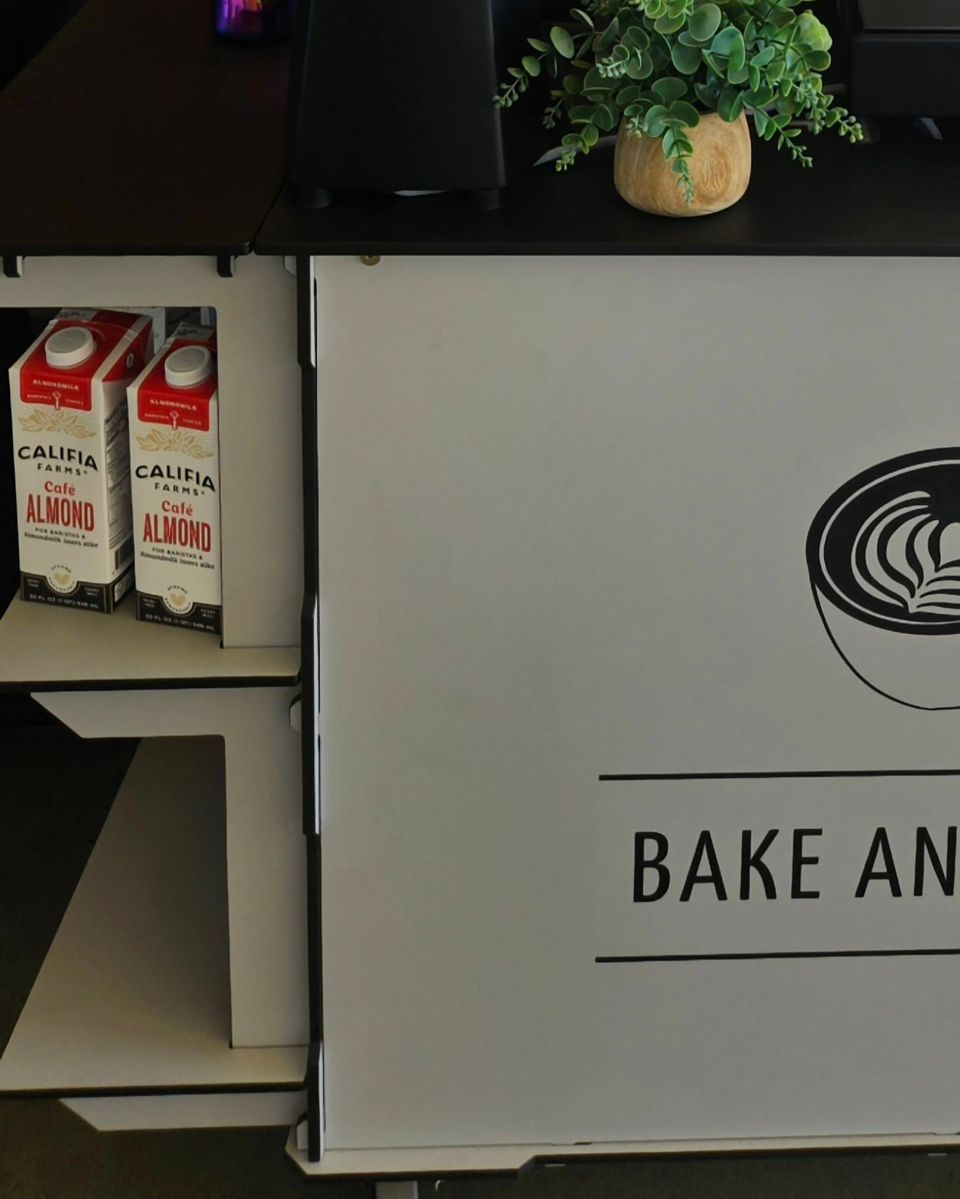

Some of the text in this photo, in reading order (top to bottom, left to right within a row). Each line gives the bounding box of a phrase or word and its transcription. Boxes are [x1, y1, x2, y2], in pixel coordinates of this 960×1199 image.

[18, 445, 98, 471] CALIFIA
[44, 480, 76, 496] Café
[135, 464, 216, 492] CALIFIA
[26, 493, 95, 532] ALMOND
[161, 500, 193, 516] Café
[143, 513, 211, 553] ALMOND
[632, 828, 823, 903] BAKE
